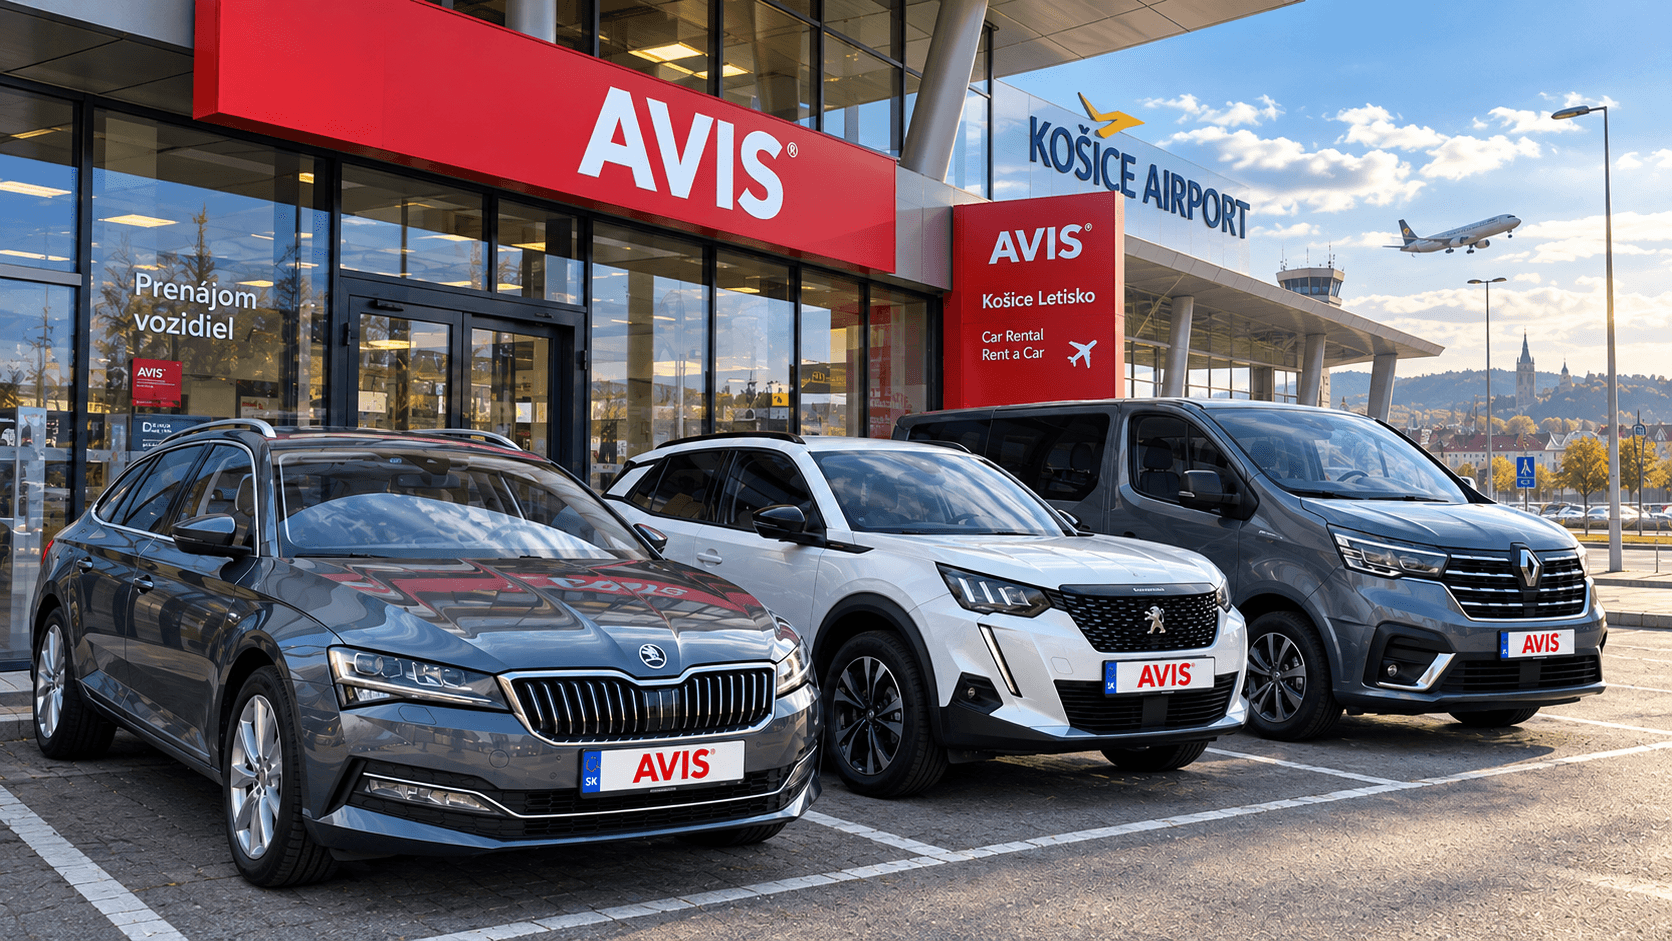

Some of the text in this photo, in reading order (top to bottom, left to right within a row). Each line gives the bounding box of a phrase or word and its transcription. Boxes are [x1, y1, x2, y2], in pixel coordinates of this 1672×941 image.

[1029, 115, 1251, 239] KOŠICE AIRPORT
[135, 271, 257, 310] Prenájom
[982, 287, 1096, 309] Košice Letisko
[133, 311, 235, 341] vozidiel
[981, 328, 1044, 344] Car Rental
[982, 346, 1045, 361] Rent a Car
[137, 366, 163, 379] AVIS
[1521, 632, 1560, 654] AVIS
[585, 776, 598, 786] SK
